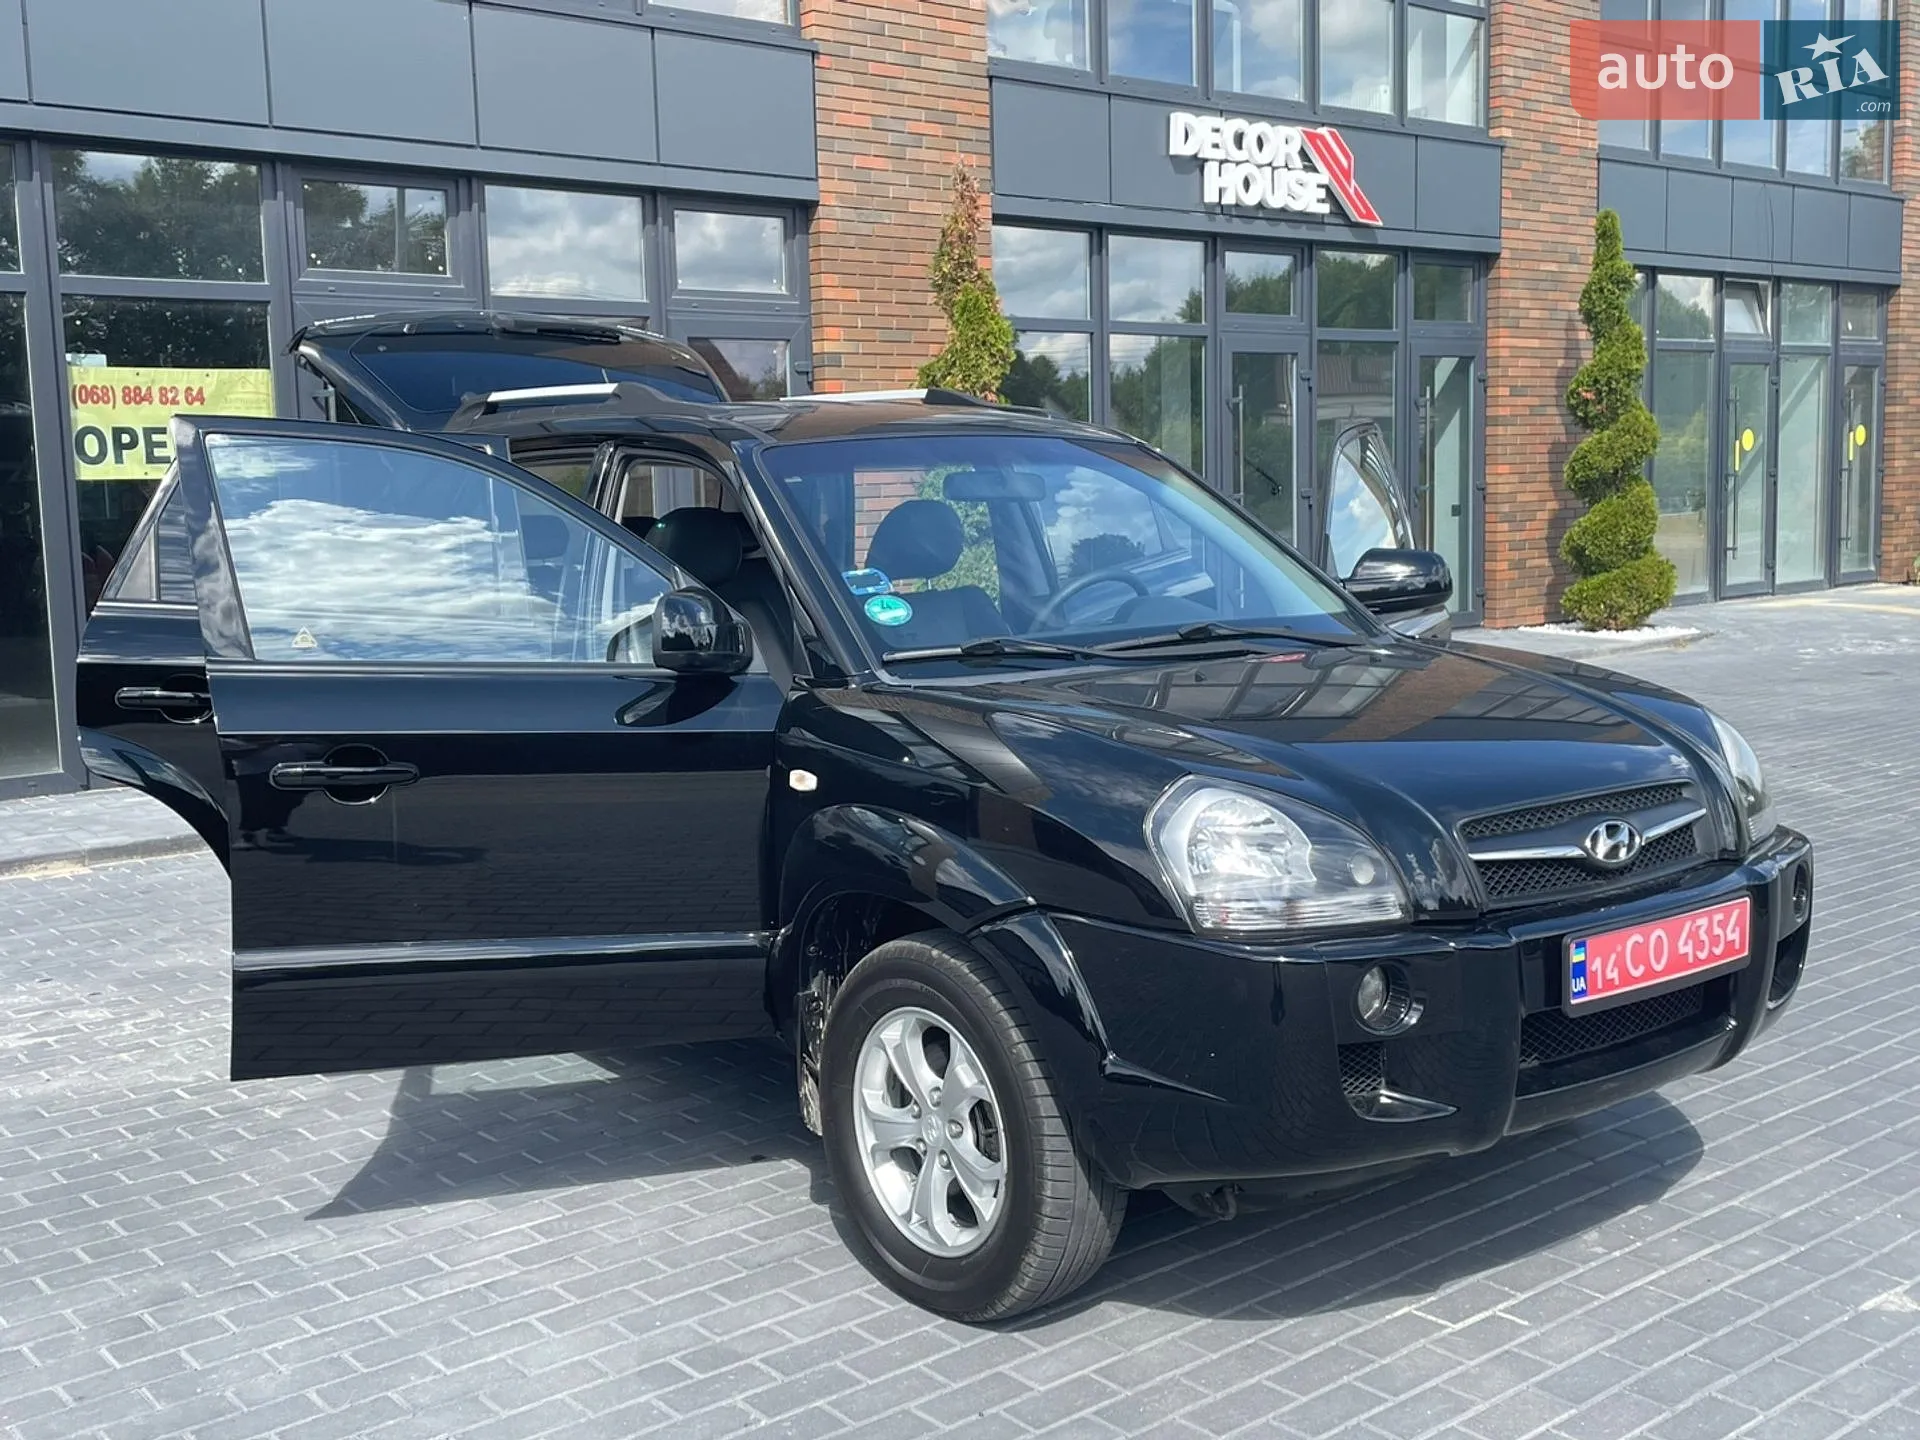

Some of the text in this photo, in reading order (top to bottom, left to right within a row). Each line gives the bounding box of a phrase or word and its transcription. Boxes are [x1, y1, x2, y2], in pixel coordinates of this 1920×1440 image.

[1169, 111, 1304, 169] DECOR
[1203, 160, 1331, 214] HOUSE
[72, 384, 116, 410] (068)
[121, 385, 153, 406] 884
[158, 386, 180, 406] 82
[184, 386, 206, 406] 64
[1571, 978, 1587, 993] UA
